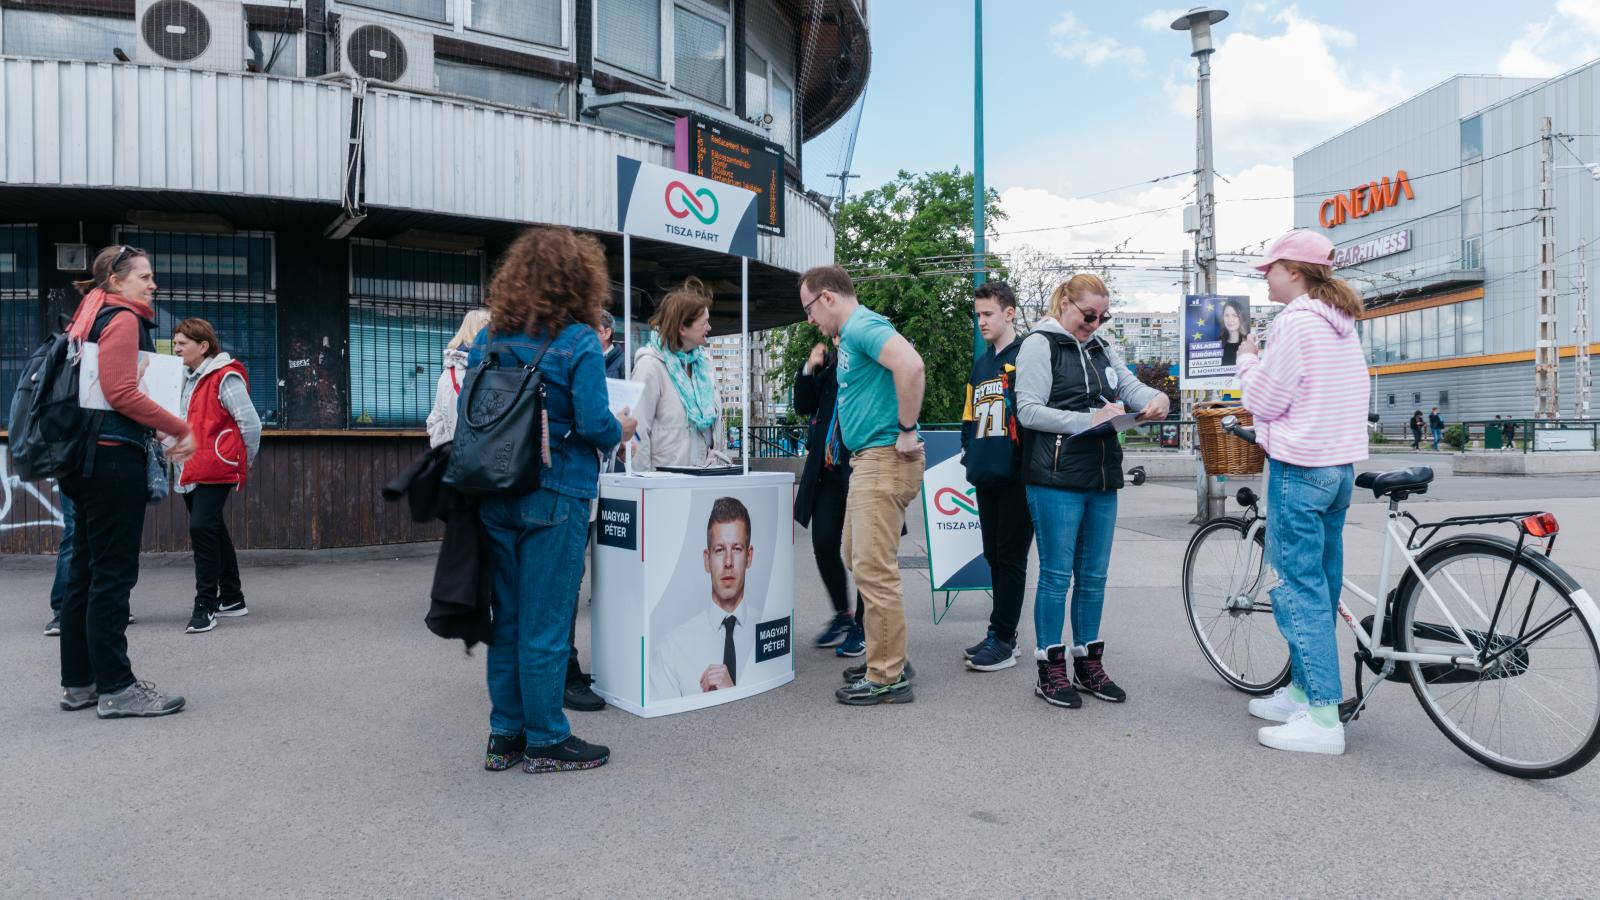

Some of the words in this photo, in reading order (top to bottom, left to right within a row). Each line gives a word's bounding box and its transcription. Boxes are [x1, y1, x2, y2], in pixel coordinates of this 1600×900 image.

[1319, 169, 1415, 229] CINEMA
[665, 224, 693, 238] TISZA
[695, 229, 720, 242] PÁRT
[974, 398, 1008, 439] 71
[601, 510, 630, 524] MAGYAR
[604, 523, 627, 538] PÉTER
[936, 521, 967, 530] TISZA
[968, 520, 982, 530] PÁ
[760, 625, 788, 640] MAGYAR
[763, 639, 785, 653] PÉTER
